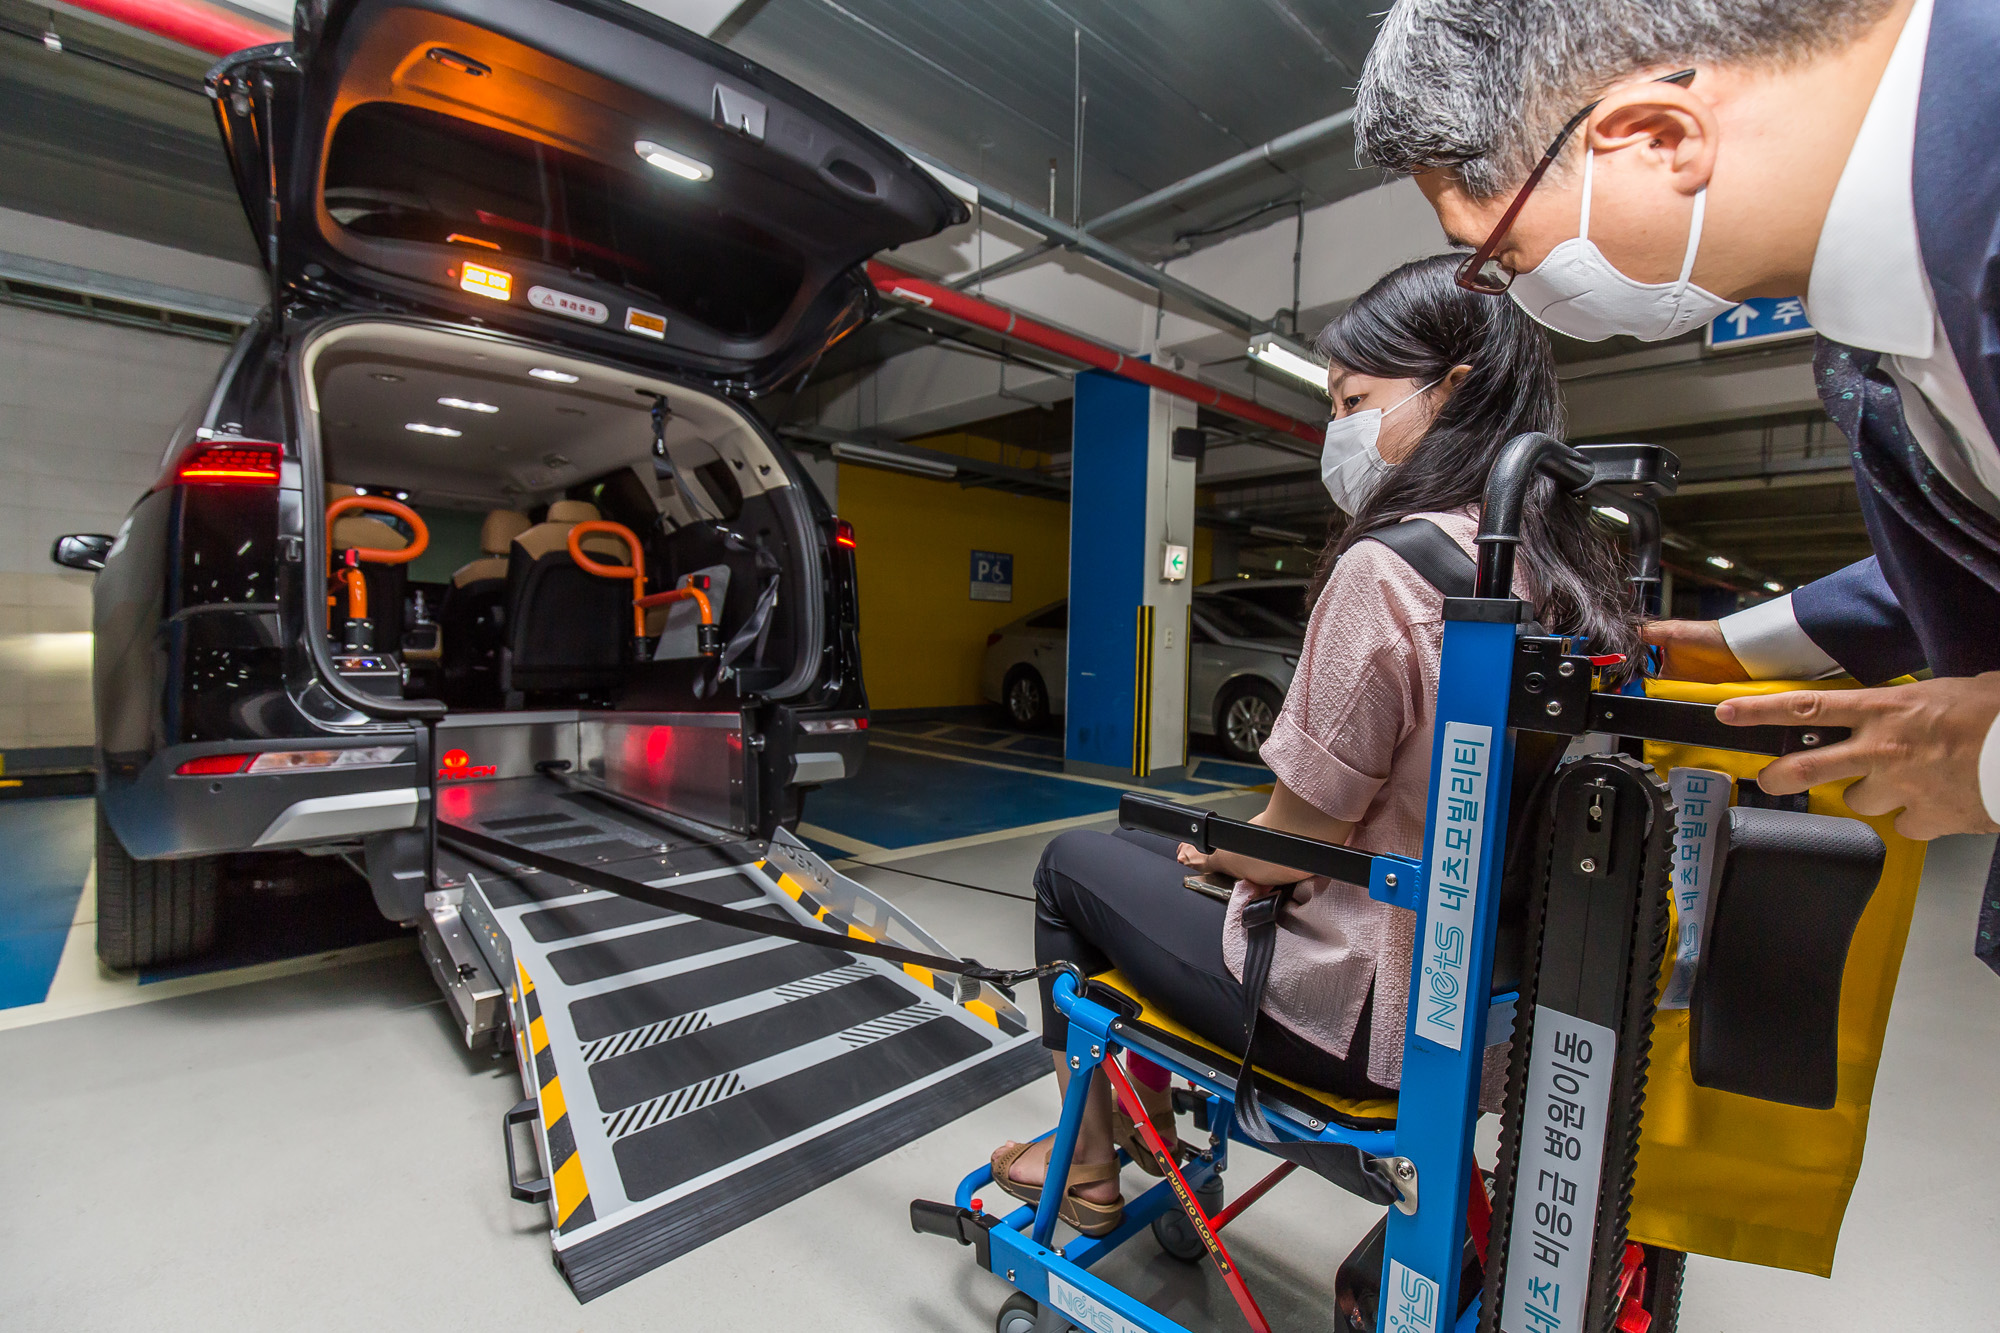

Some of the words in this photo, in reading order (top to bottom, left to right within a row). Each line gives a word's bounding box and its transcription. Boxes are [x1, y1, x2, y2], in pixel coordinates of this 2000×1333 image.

[978, 560, 990, 580] P
[1438, 738, 1485, 912] 네츠모빌리티
[1680, 775, 1716, 912] 네츠모빌리티
[1543, 1031, 1593, 1162] 병원이동
[1167, 1171, 1187, 1200] PUSH
[1185, 1200, 1197, 1216] TO
[1194, 1217, 1219, 1253] CLOSE
[1532, 1168, 1579, 1269] 비응급
